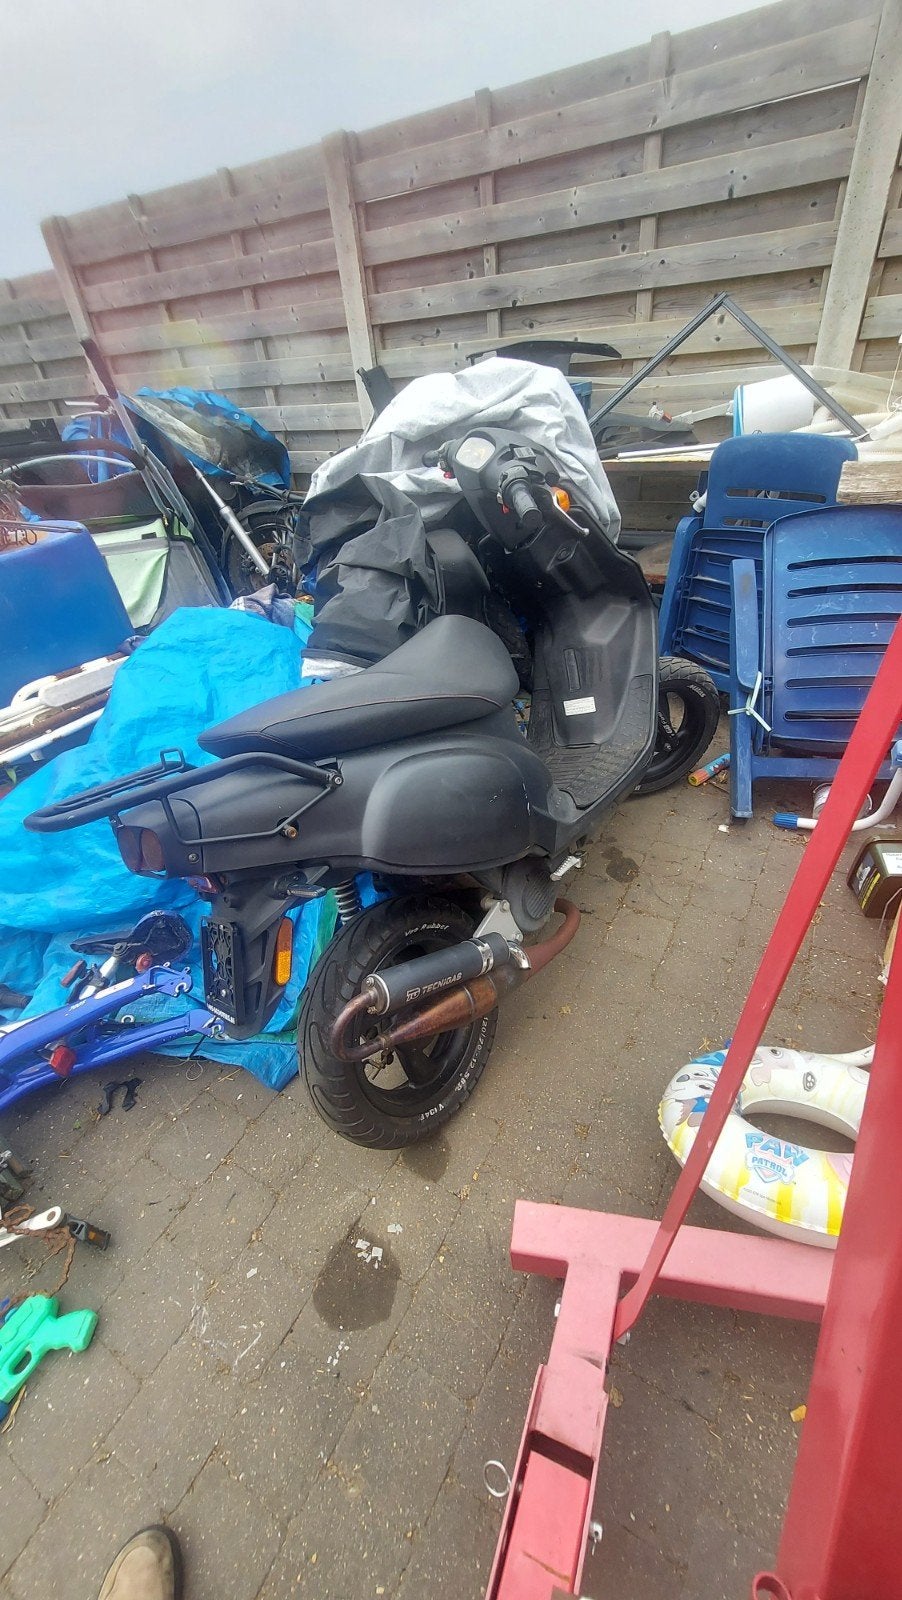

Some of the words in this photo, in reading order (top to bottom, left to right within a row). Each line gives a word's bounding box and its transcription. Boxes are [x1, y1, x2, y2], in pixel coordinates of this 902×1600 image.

[422, 972, 463, 995] TECNIGAS
[745, 1133, 810, 1167] PAW
[752, 1156, 788, 1177] PATROL
